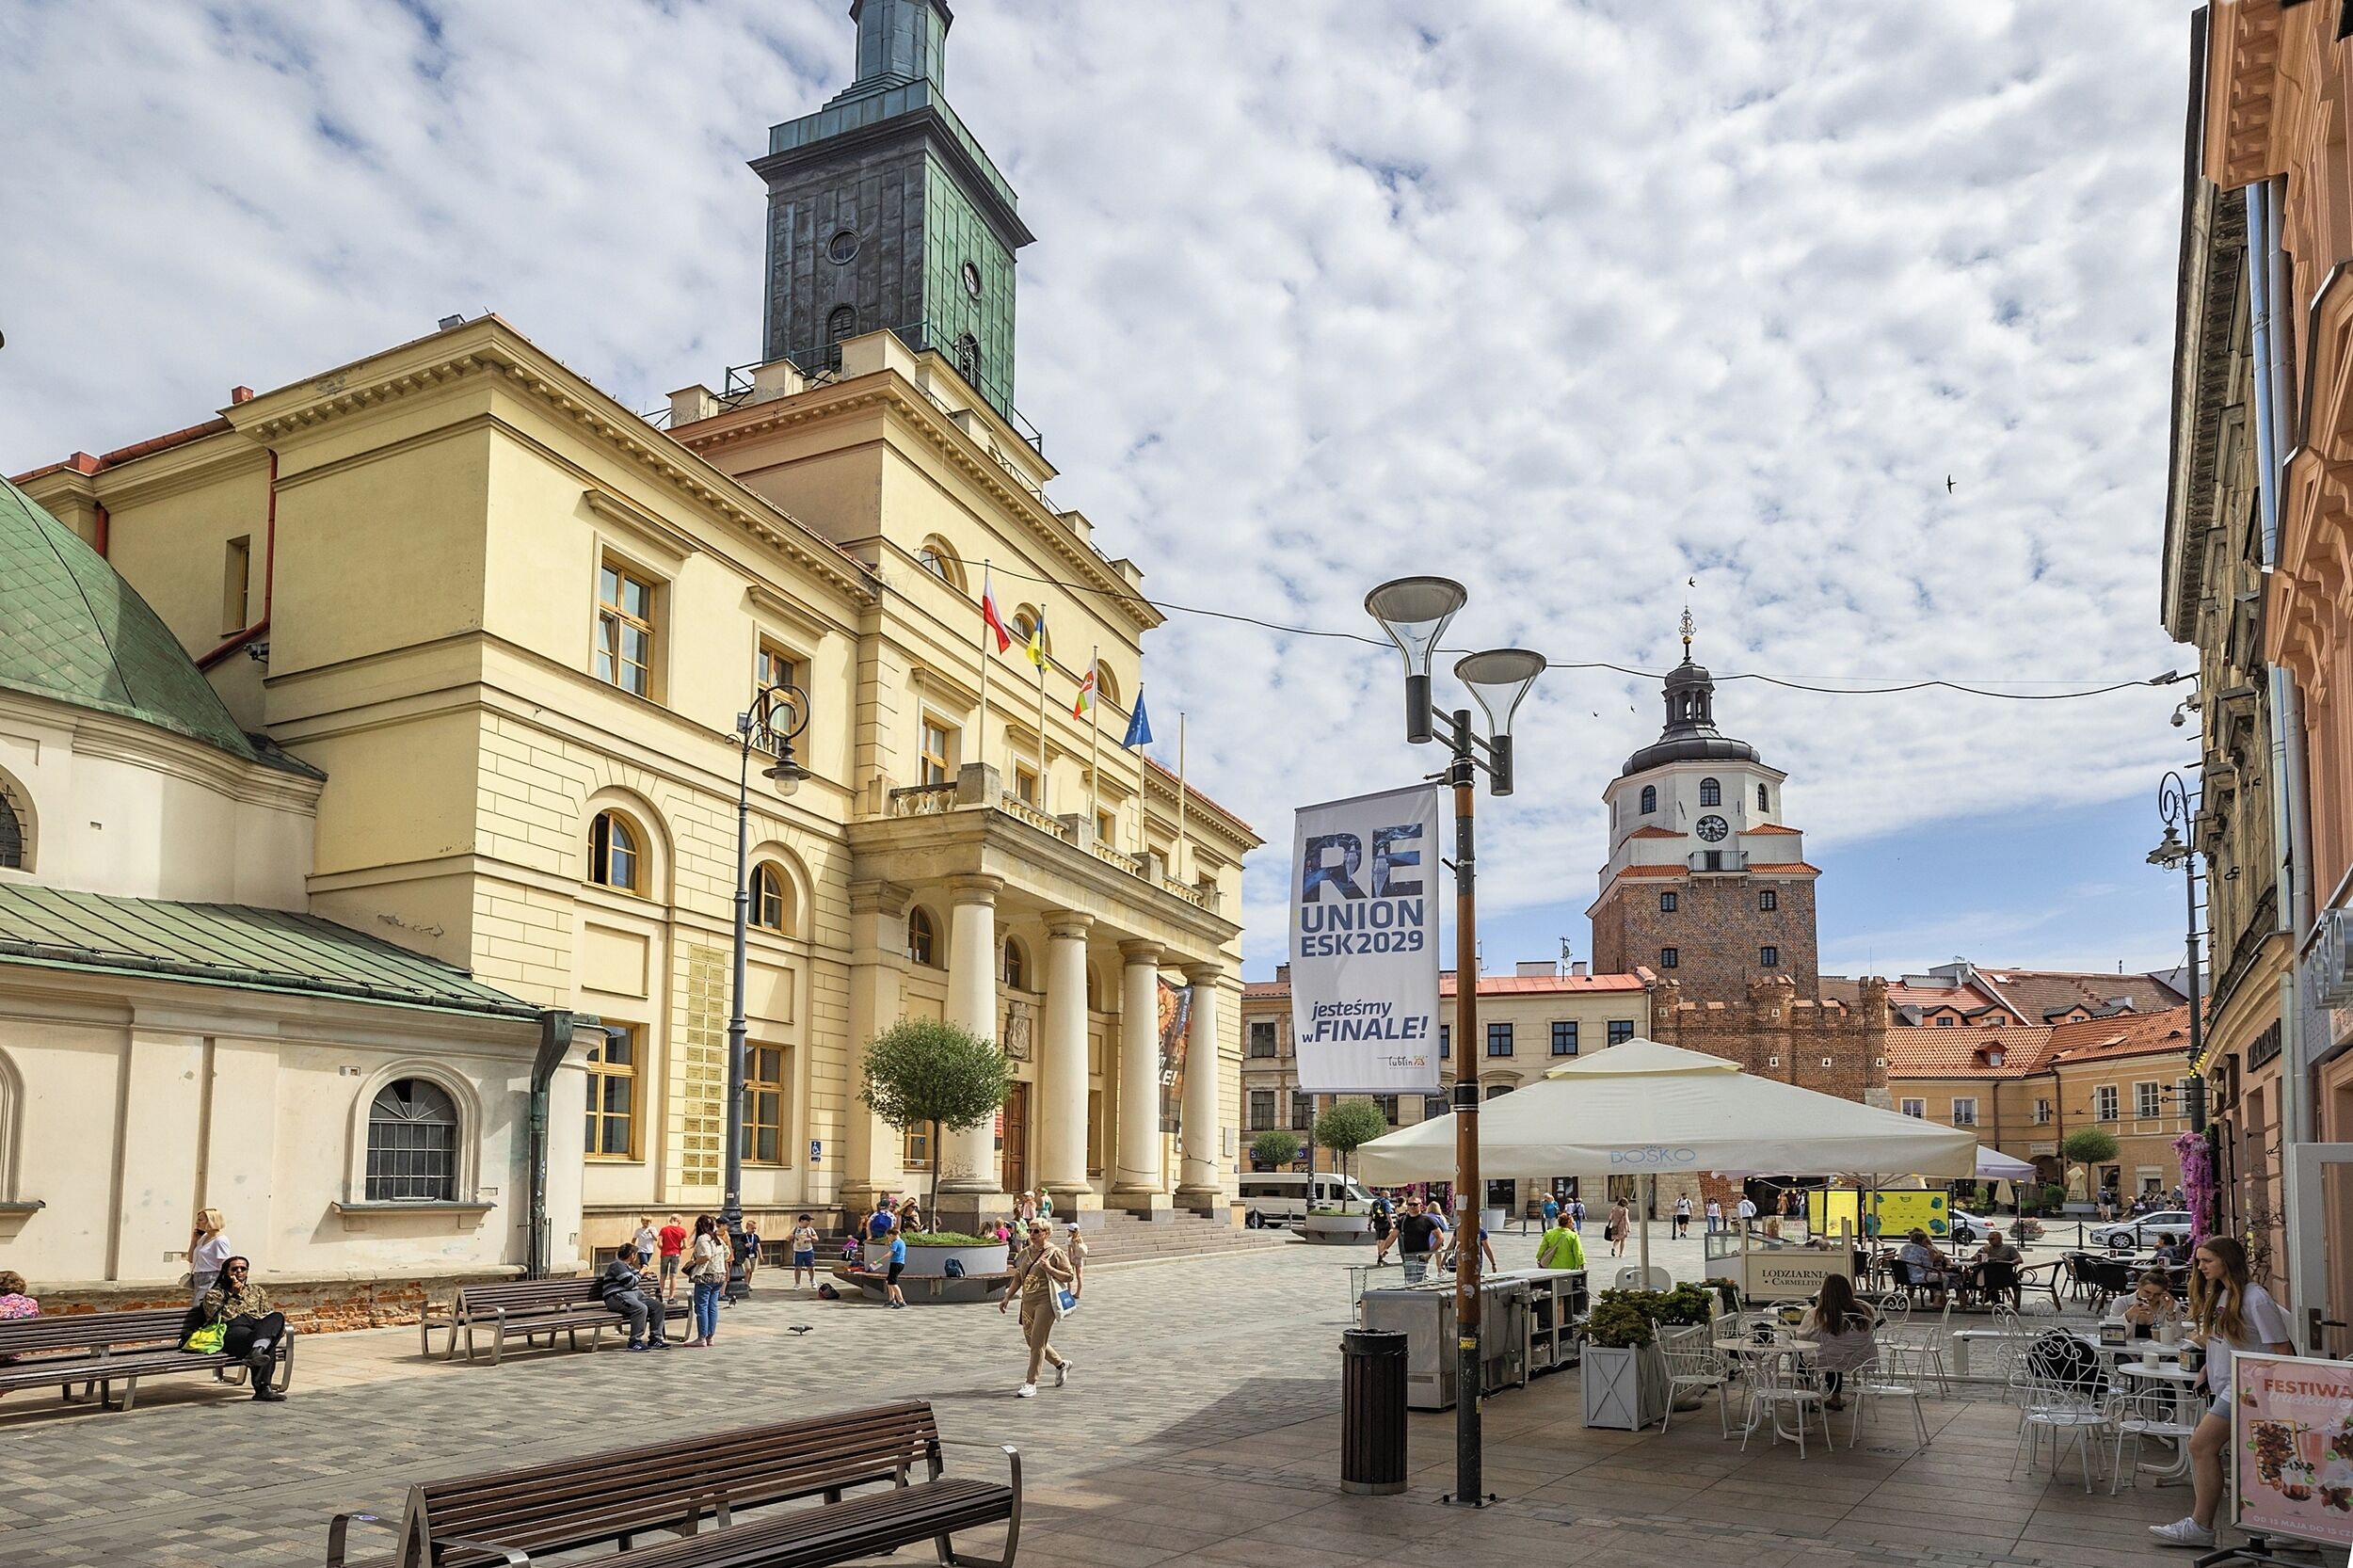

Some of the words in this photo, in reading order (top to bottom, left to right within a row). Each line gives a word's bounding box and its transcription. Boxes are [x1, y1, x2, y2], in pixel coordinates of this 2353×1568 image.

[1302, 823, 1423, 904] RE
[1302, 899, 1423, 933] UNION
[1311, 999, 1393, 1021] jesteśmy
[1315, 1016, 1429, 1042] FINALE!
[1762, 1269, 1830, 1279] LODZIARNIA
[2281, 1521, 2307, 1530] MAJA
